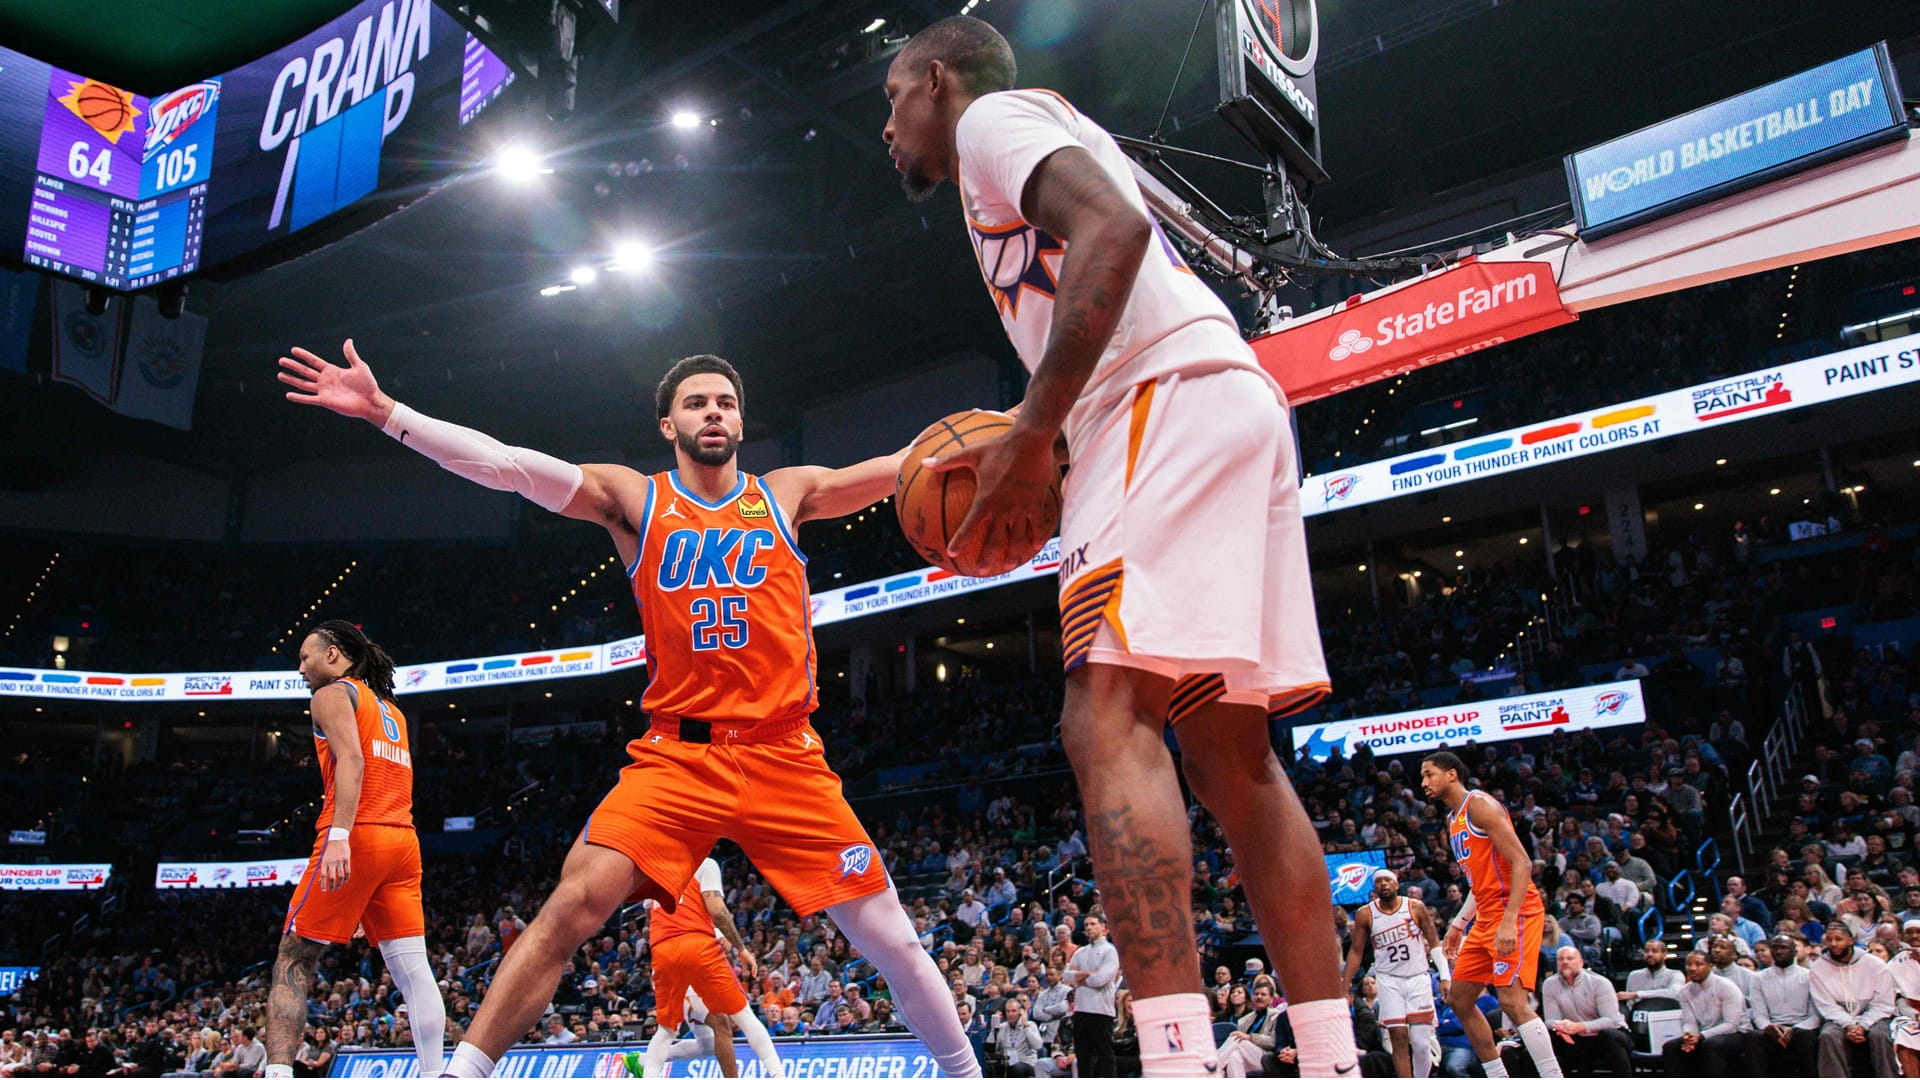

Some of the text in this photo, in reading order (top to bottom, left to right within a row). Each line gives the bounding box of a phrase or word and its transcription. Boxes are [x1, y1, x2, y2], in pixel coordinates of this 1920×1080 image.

[1263, 52, 1315, 121] TISSOT
[1585, 78, 1874, 202] WORLD BASKETBALL DAY
[68, 141, 112, 187] 64
[156, 143, 198, 191] 105
[38, 175, 64, 191] PLAYER
[110, 198, 125, 209] PTS
[31, 214, 66, 232] GILLESPIE
[1824, 355, 1890, 386] PAINT
[1692, 372, 1782, 400] SPECTRUM
[1694, 386, 1766, 415] PAINT
[1392, 419, 1661, 491] FIND YOUR THUNDER PAINT COLORS AT
[657, 527, 776, 592] OKC
[845, 601, 864, 614] FIND
[866, 596, 888, 609] YOUR
[891, 586, 931, 605] THUNDER
[933, 580, 958, 596] PAINT
[690, 595, 749, 652] 25
[250, 679, 280, 690] PAINT
[465, 673, 485, 683] YOUR
[487, 669, 524, 681] THUNDER
[525, 667, 547, 677] PAINT
[550, 663, 581, 674] COLORS
[583, 661, 593, 671] AT
[20, 684, 44, 692] YOUR
[47, 684, 88, 695] THUNDER
[90, 686, 117, 696] PAINT
[120, 686, 153, 697] COLORS
[155, 687, 165, 697] AT
[184, 682, 221, 690] PAINT
[1498, 698, 1564, 713] SPECTRUM
[1500, 708, 1552, 725] PAINT
[376, 697, 400, 742] 6
[1359, 711, 1480, 736] THUNDER UP
[1410, 725, 1482, 743] COLORS
[1374, 925, 1408, 948] SUNS
[1387, 944, 1410, 963] 23
[543, 1055, 583, 1078] DAY
[783, 1056, 907, 1078] DECEMBER
